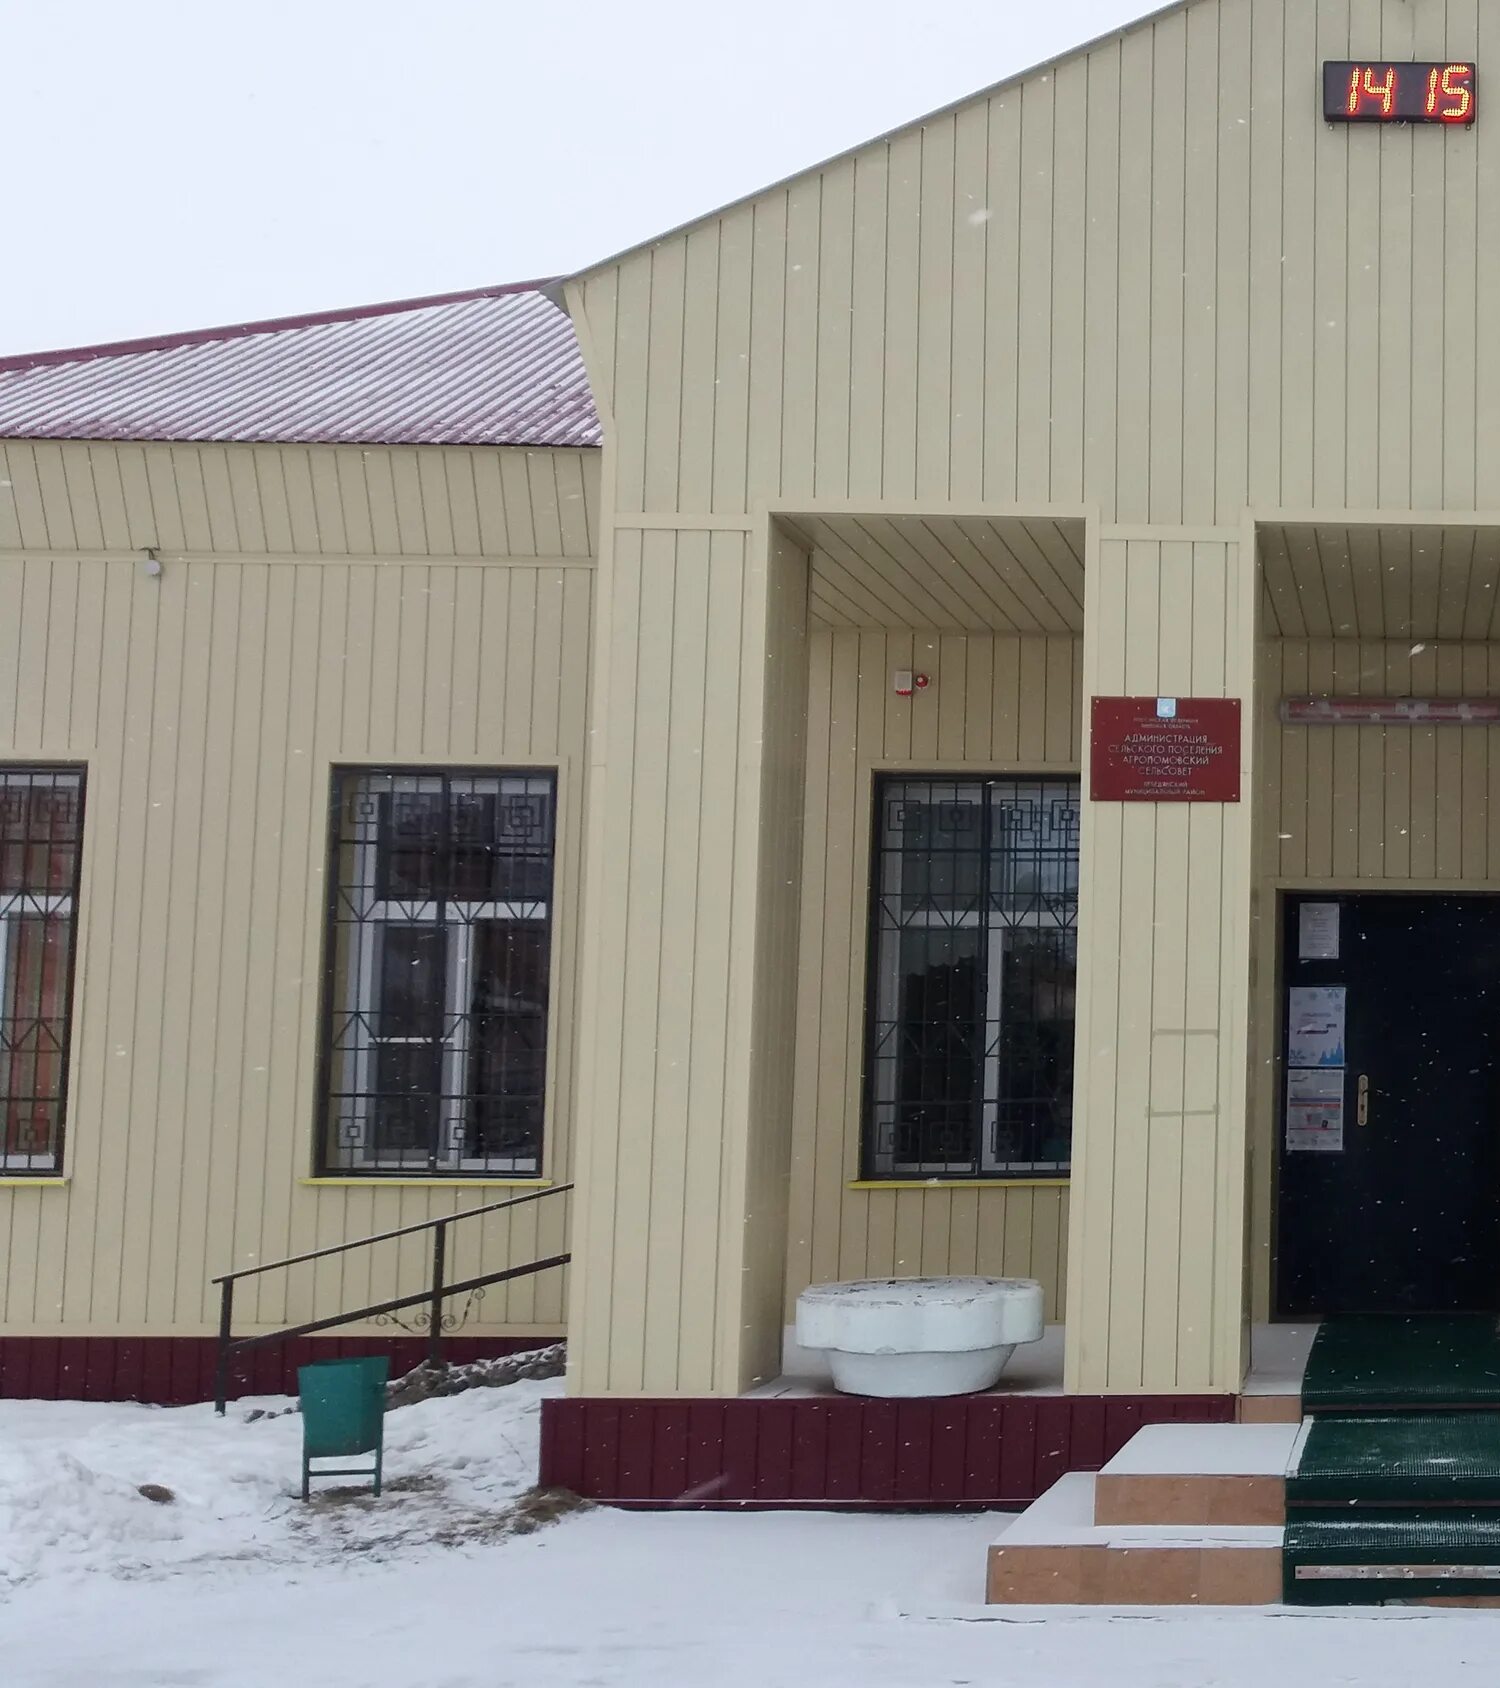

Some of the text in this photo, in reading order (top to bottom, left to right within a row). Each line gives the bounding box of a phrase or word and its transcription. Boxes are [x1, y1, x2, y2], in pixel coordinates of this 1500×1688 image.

[1348, 65, 1470, 117] 14 15
[1124, 734, 1208, 743] АДМИНИСТРАЦИЯ
[1108, 744, 1223, 755] СЕЛЬСКОГО ПОСЕЛЕНИЯ
[1138, 766, 1193, 776] СЕЛЬСОВЕТ
